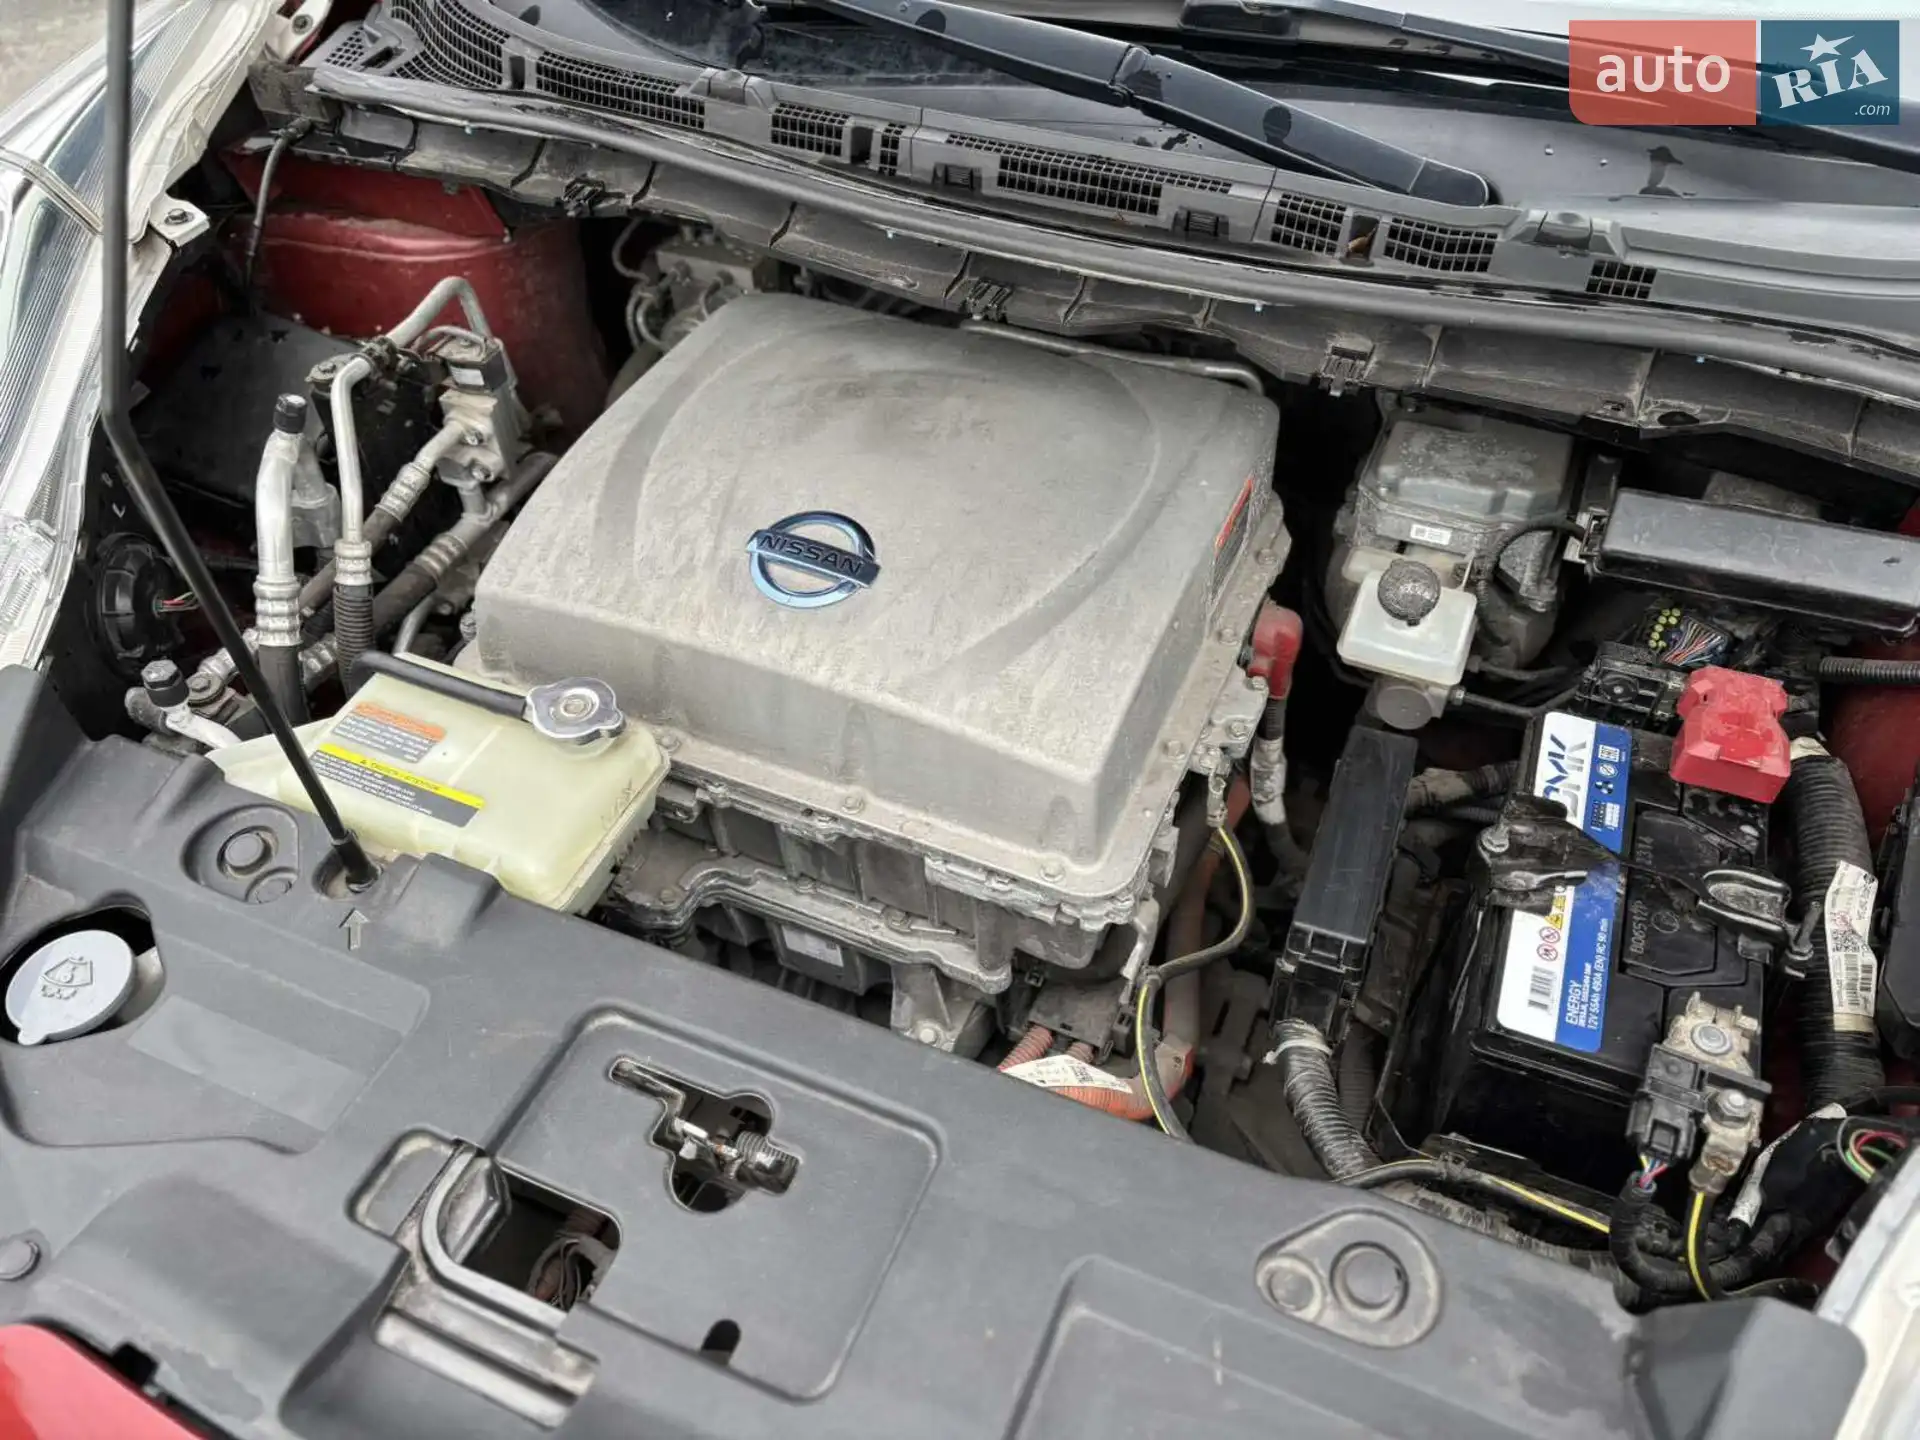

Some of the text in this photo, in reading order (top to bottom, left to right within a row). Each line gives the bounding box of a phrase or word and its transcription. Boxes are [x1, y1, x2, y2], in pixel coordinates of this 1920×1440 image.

[758, 535, 862, 575] NISSAN
[1596, 943, 1607, 956] RC
[1594, 955, 1606, 973] (EN)
[1565, 980, 1581, 1024] ENERGY
[1589, 993, 1600, 1014] 55Ah
[1587, 1015, 1598, 1030] 12V
